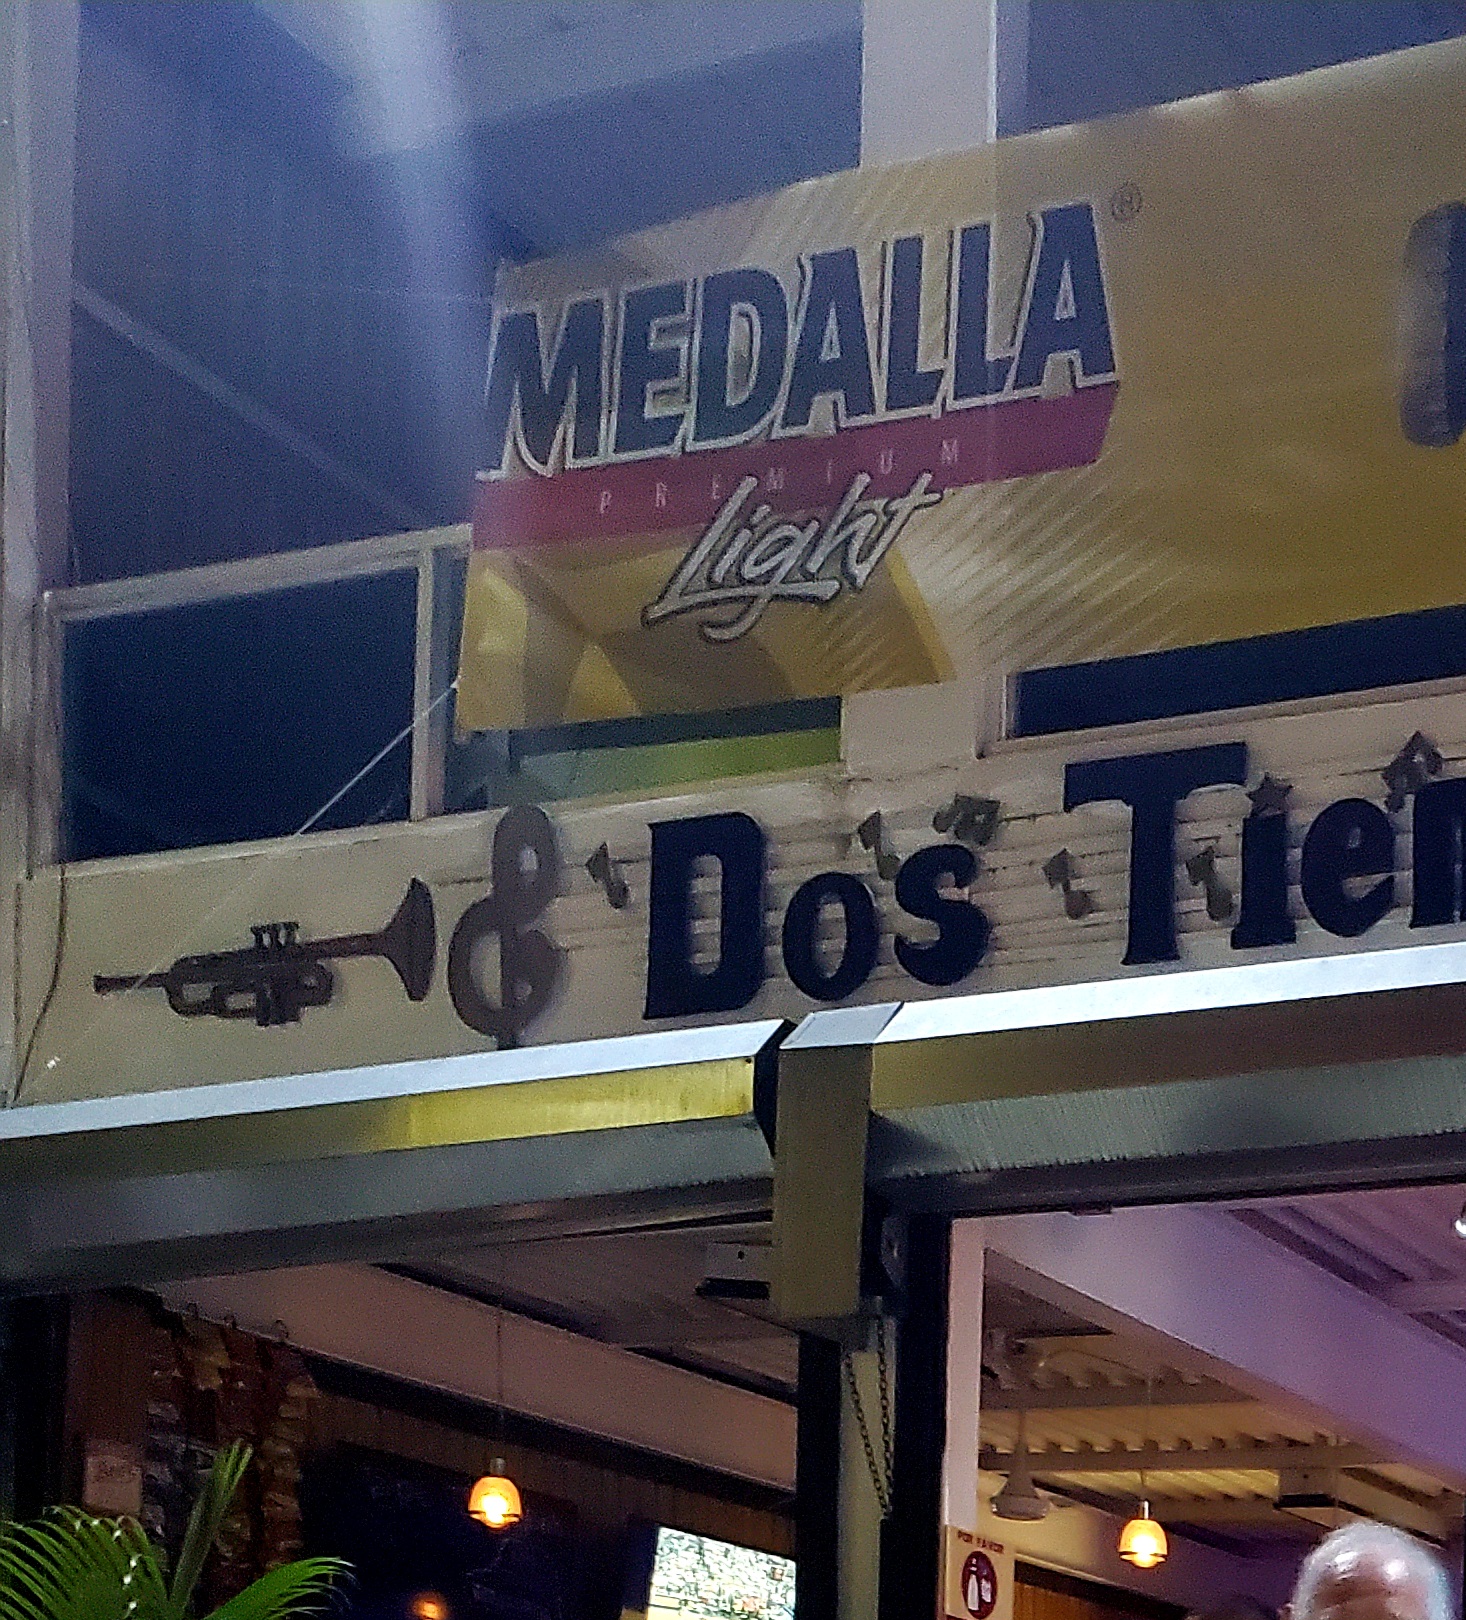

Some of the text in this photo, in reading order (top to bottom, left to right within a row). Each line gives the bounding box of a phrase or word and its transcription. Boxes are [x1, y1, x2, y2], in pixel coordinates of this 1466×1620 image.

[480, 201, 1118, 478] MEDALLA
[600, 438, 959, 514] PREMIUM
[641, 471, 942, 641] Light
[642, 810, 992, 1020] Dos
